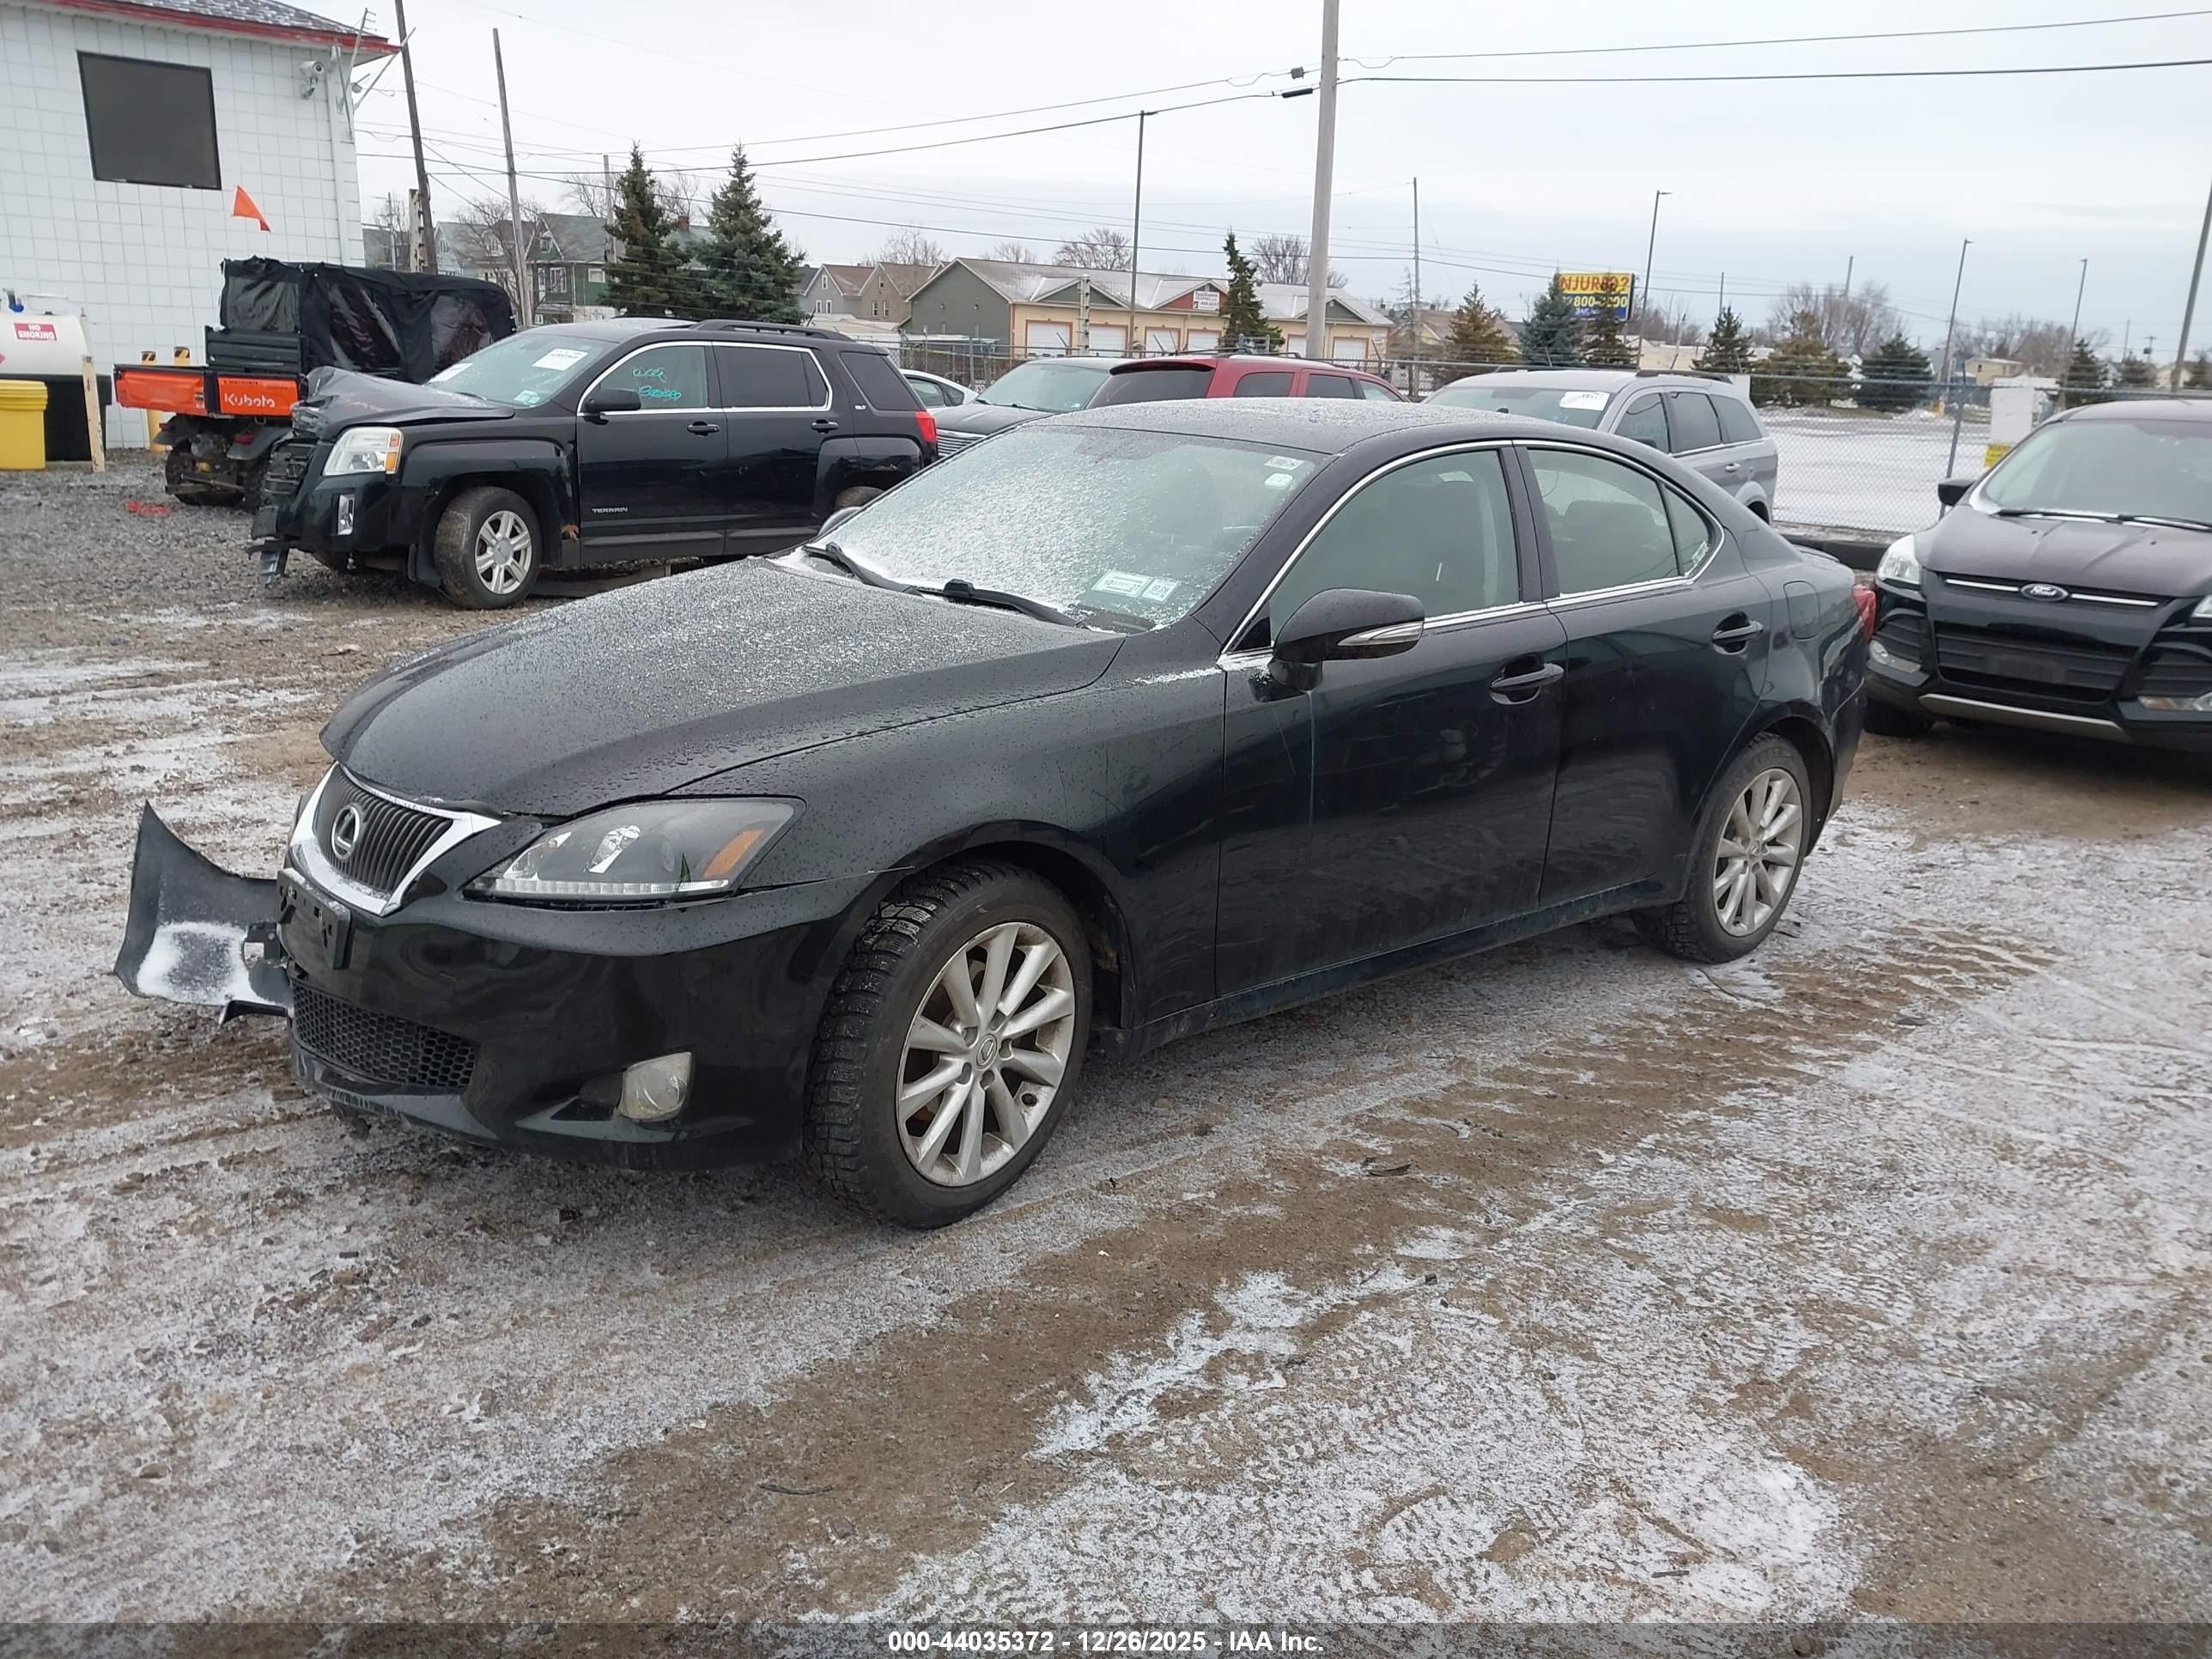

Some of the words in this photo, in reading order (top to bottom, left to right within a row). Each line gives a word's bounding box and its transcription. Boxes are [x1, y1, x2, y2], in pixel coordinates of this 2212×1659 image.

[18, 330, 55, 339] SMOKING
[224, 392, 276, 408] Kubota
[2029, 585, 2057, 596] Ford
